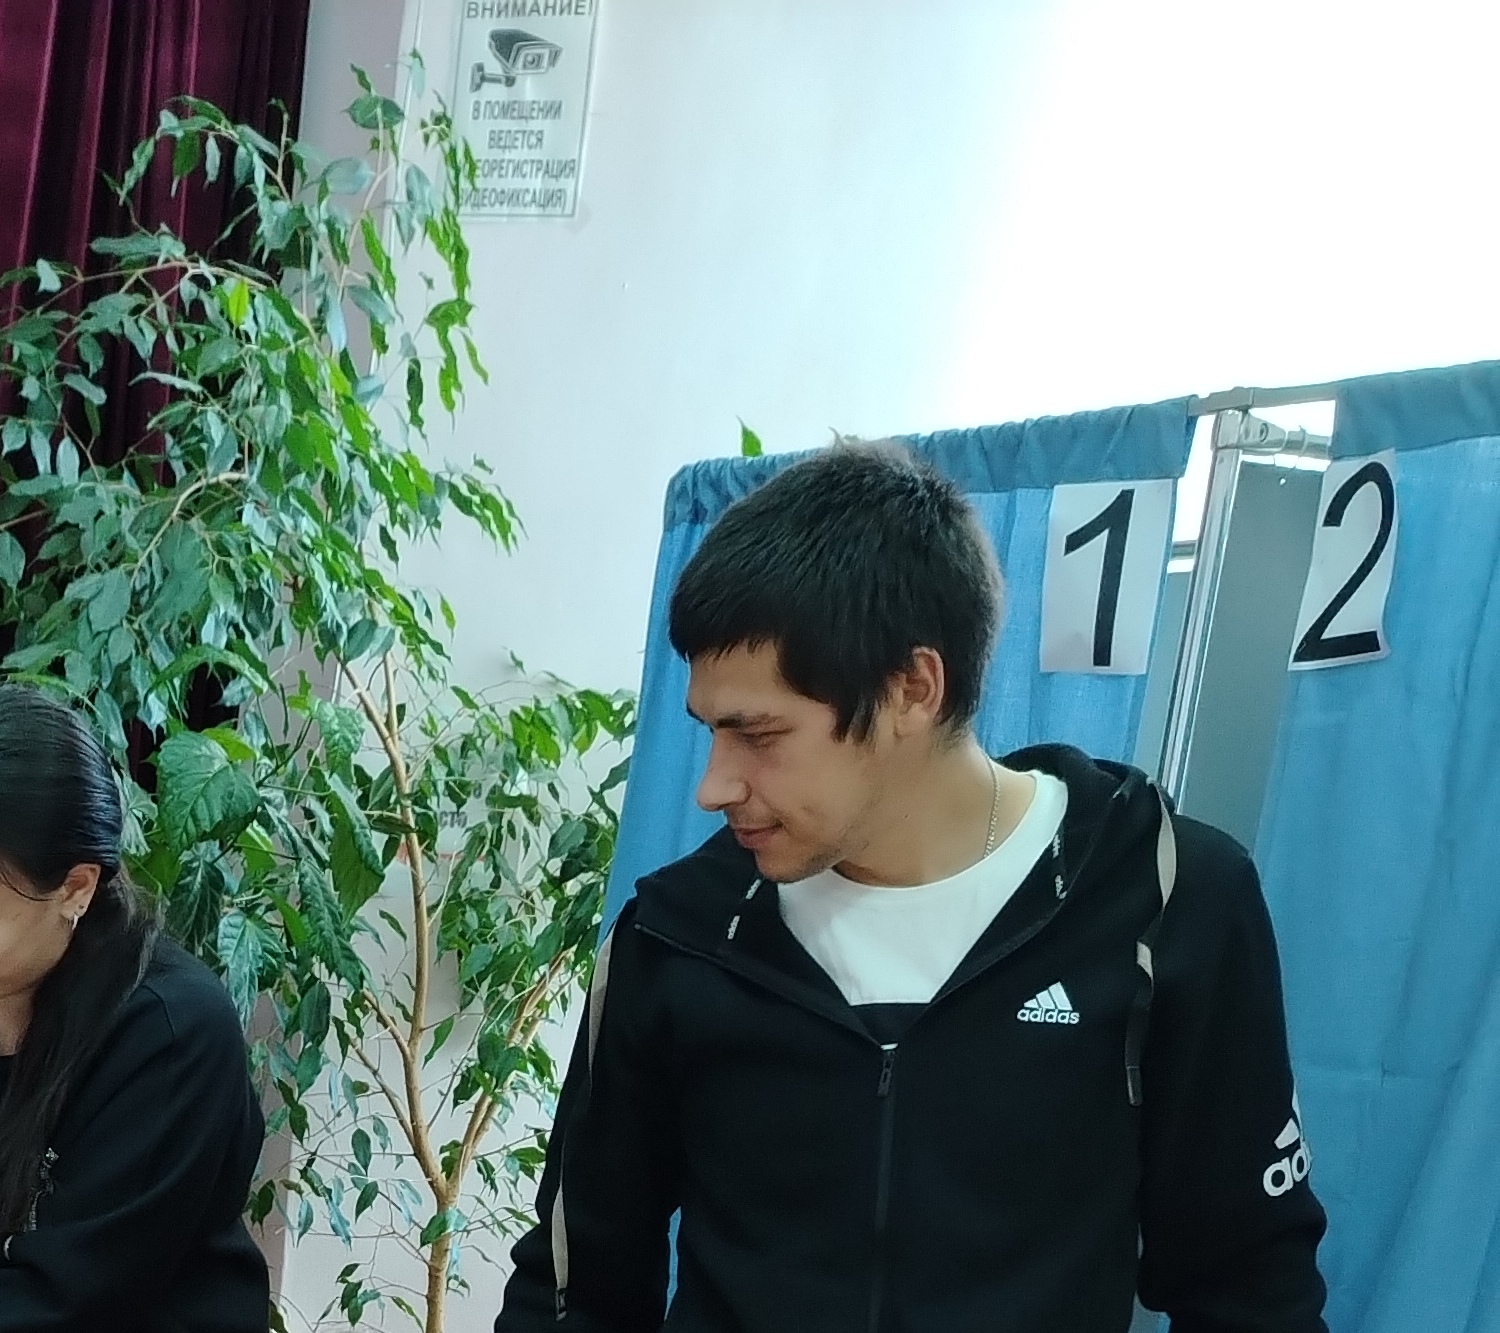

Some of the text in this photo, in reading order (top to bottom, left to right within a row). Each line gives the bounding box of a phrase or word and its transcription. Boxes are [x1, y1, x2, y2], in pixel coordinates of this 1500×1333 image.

[471, 100, 563, 124] В ПОМЕЩЕНИИ
[488, 130, 544, 153] ВЕДЕТСЯ
[1293, 461, 1395, 662] 2
[1063, 489, 1135, 666] 1
[1016, 1007, 1080, 1024] adidas
